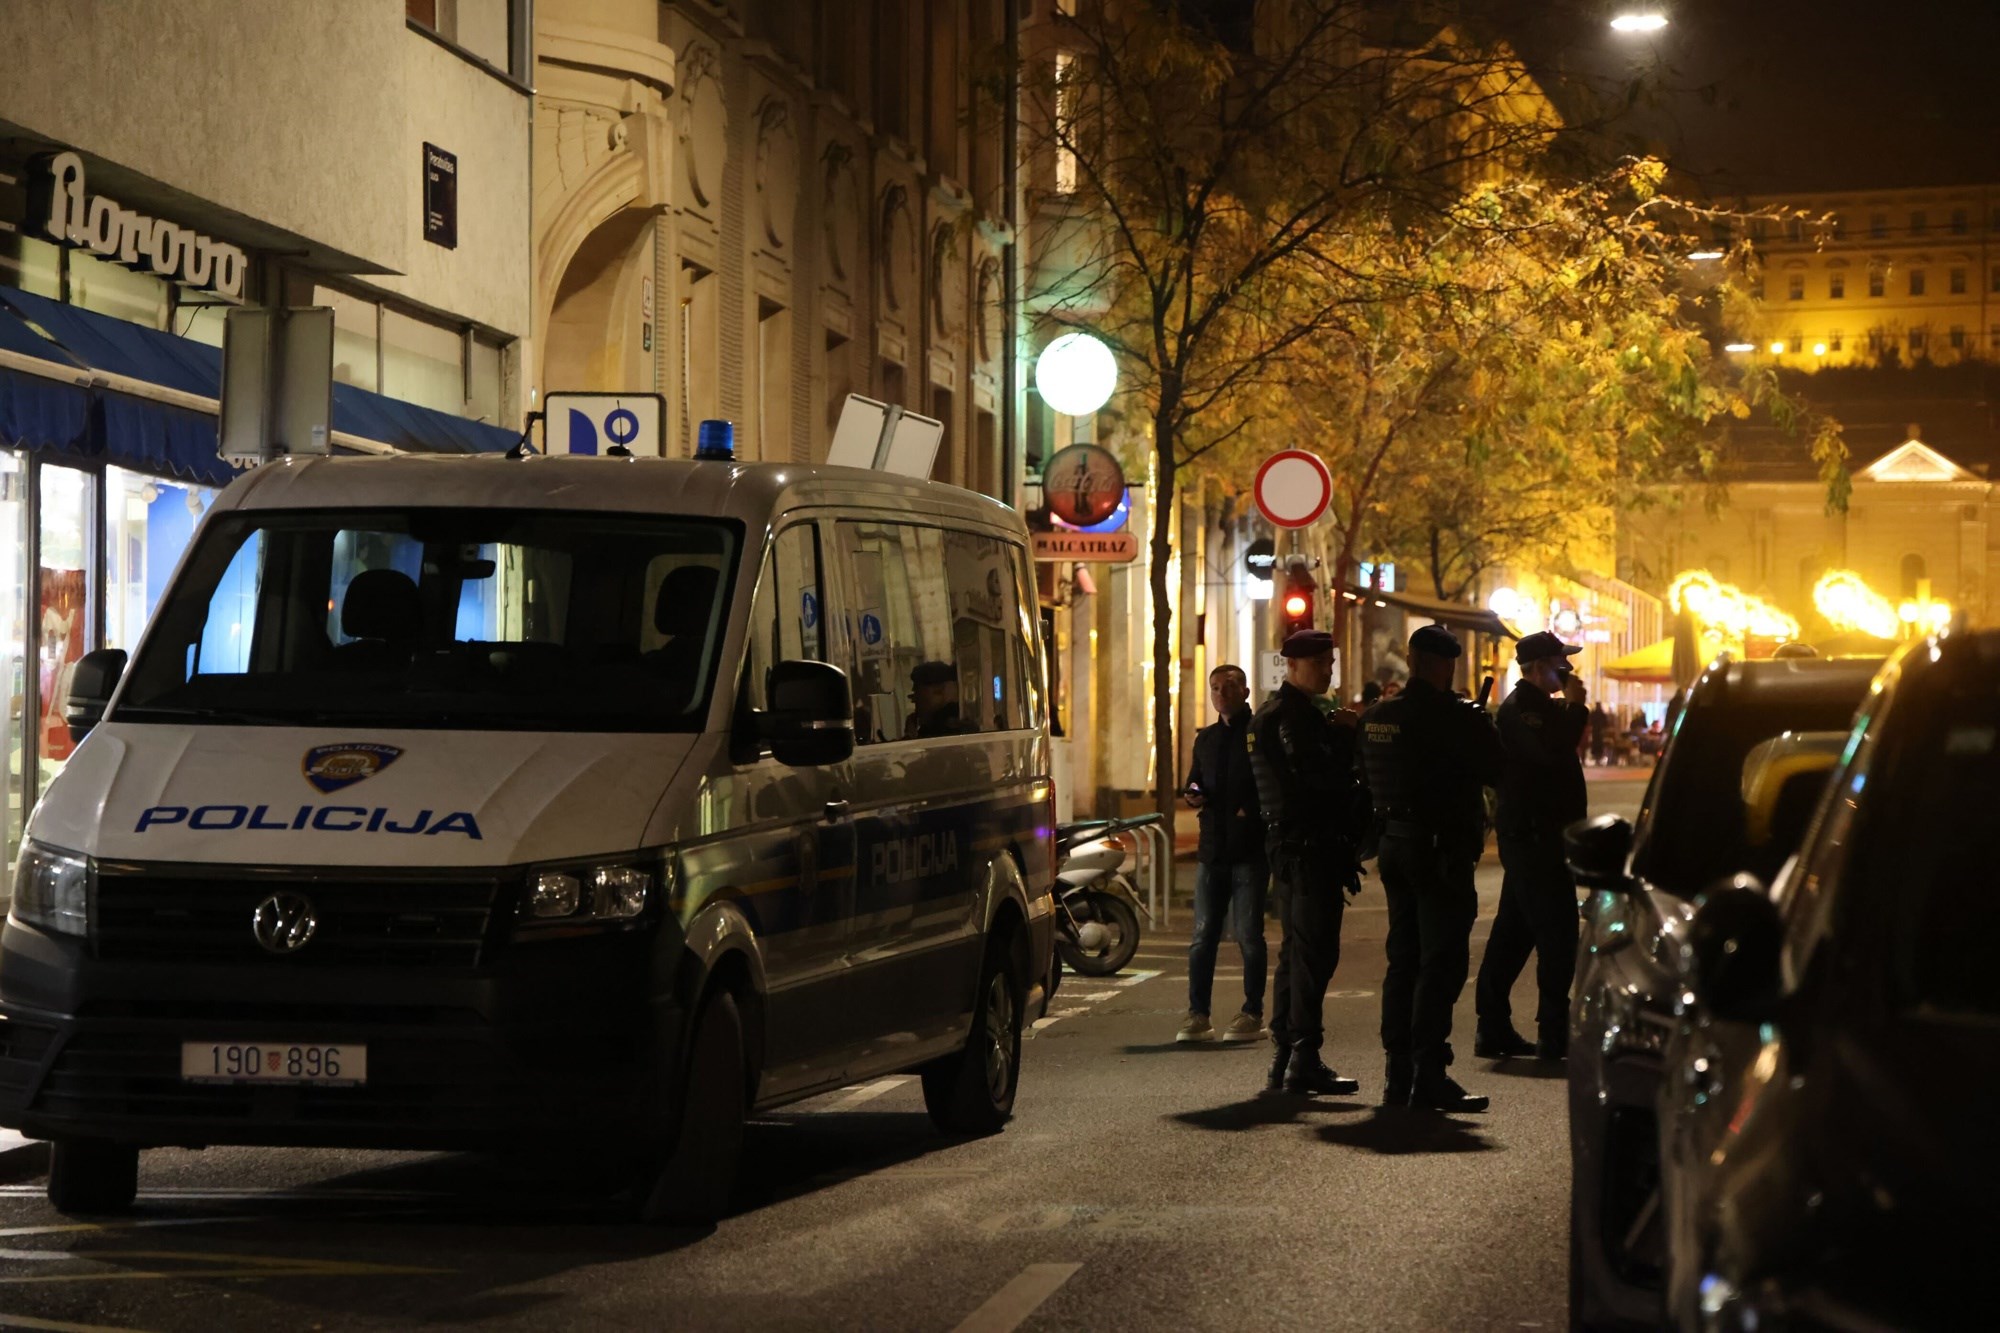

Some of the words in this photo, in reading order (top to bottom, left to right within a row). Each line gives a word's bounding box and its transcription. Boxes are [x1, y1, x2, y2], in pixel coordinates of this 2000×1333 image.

[1051, 540, 1126, 553] ALCATRAZ
[315, 745, 399, 756] POLICIJA
[134, 805, 483, 840] POLICIJA
[871, 830, 959, 887] POLICIJA
[212, 1046, 261, 1075] 190
[287, 1047, 340, 1077] 896
